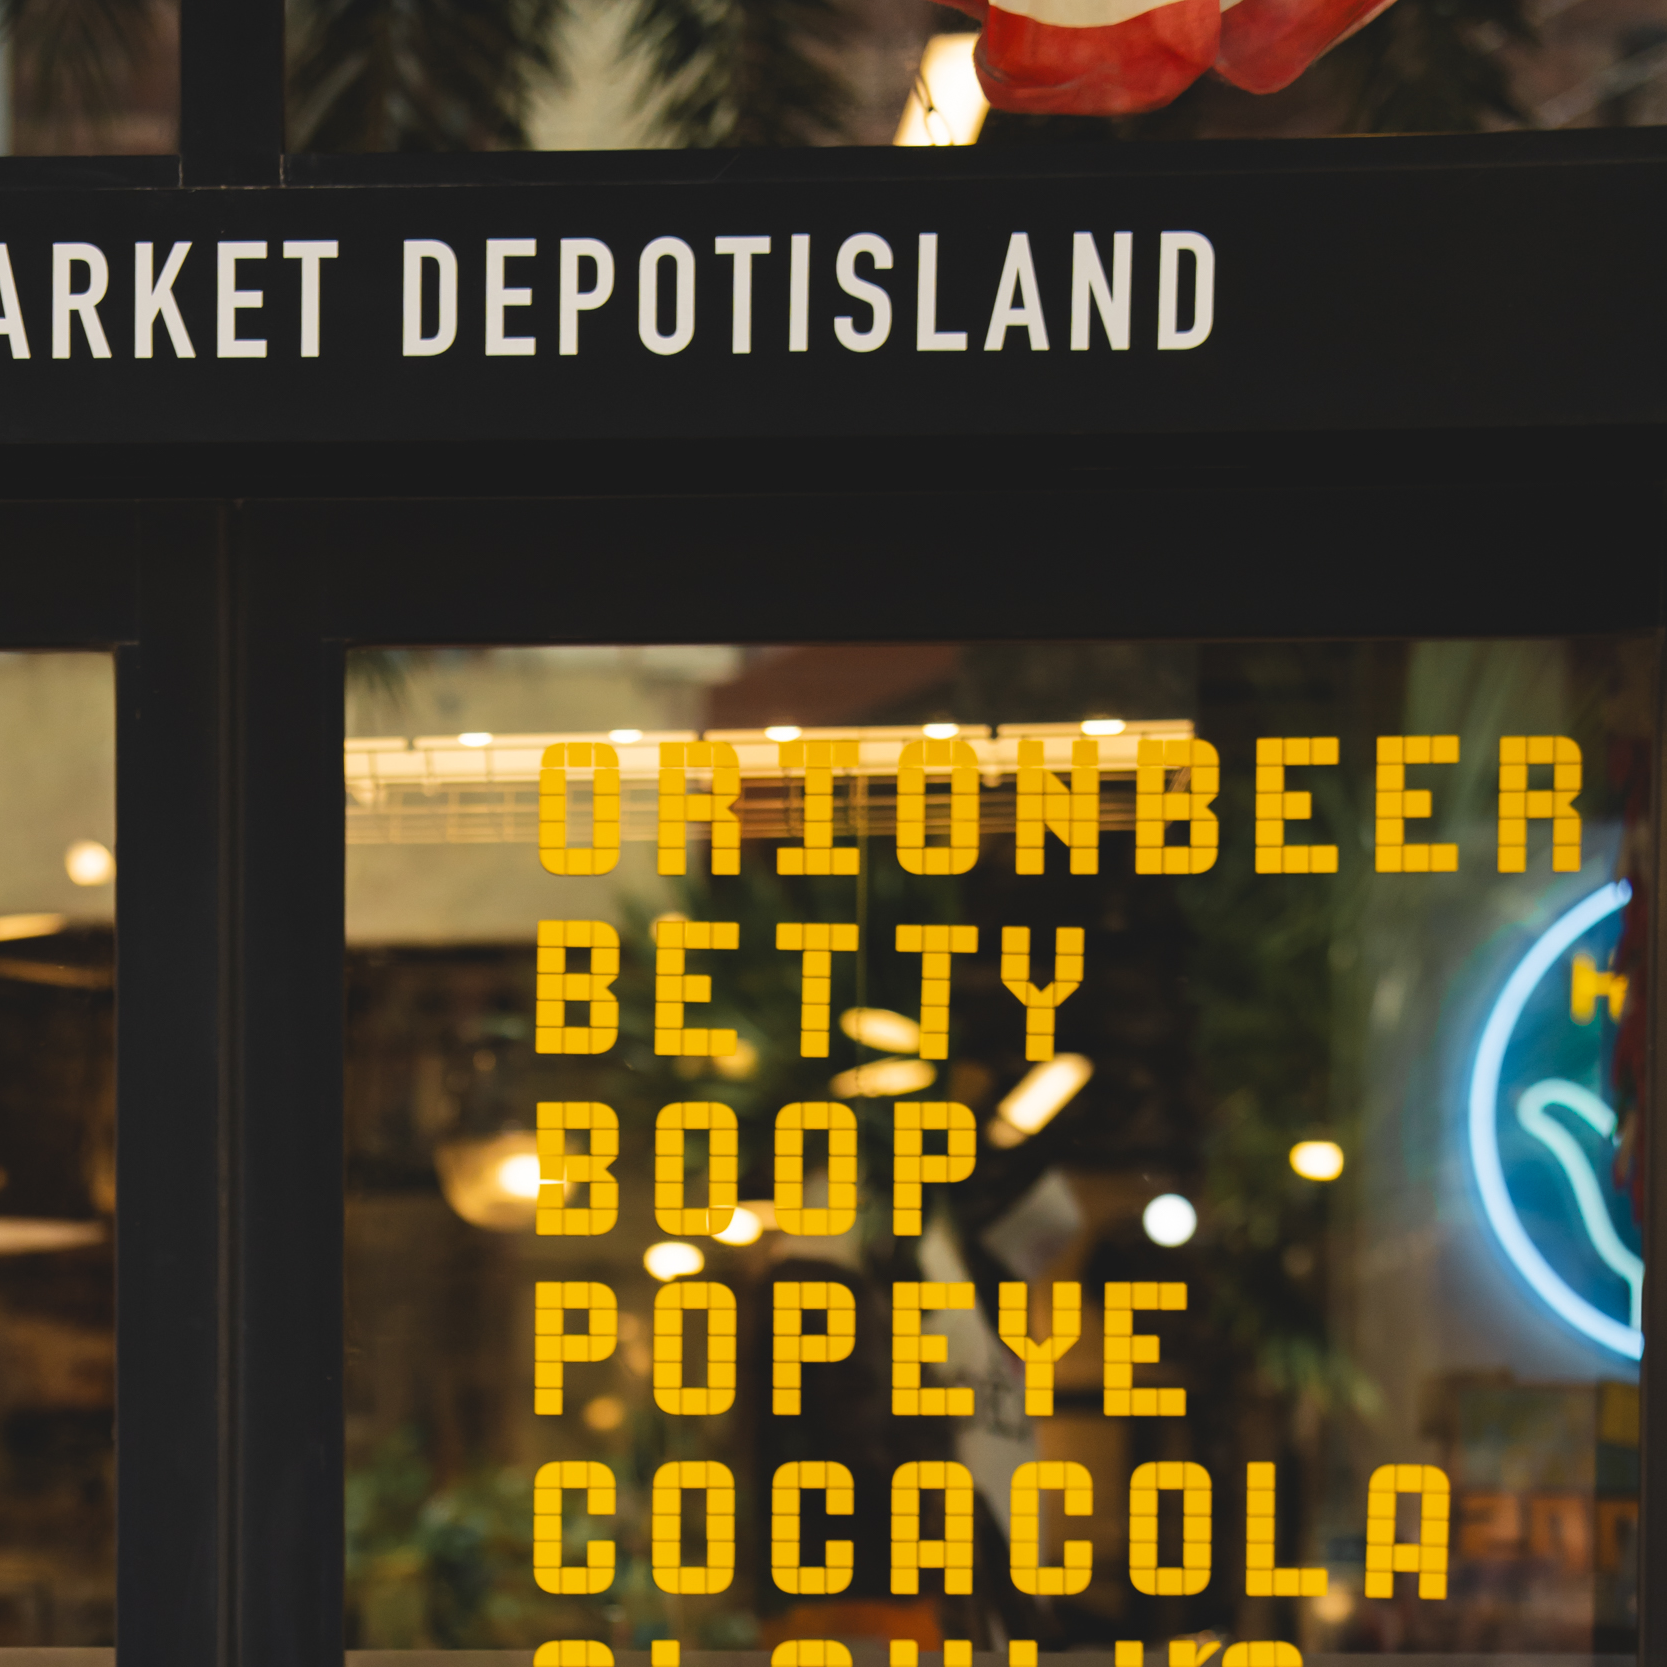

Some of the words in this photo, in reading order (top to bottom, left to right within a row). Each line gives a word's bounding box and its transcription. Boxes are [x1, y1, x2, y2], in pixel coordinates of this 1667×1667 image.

[402, 231, 1216, 356] DEPOTISLAND
[538, 736, 1583, 876] ORIONBEER
[536, 919, 1086, 1062] BETTY
[535, 1101, 977, 1237] BOOP
[534, 1281, 1187, 1417] POPEYE
[533, 1461, 1451, 1599] COCACOLA
